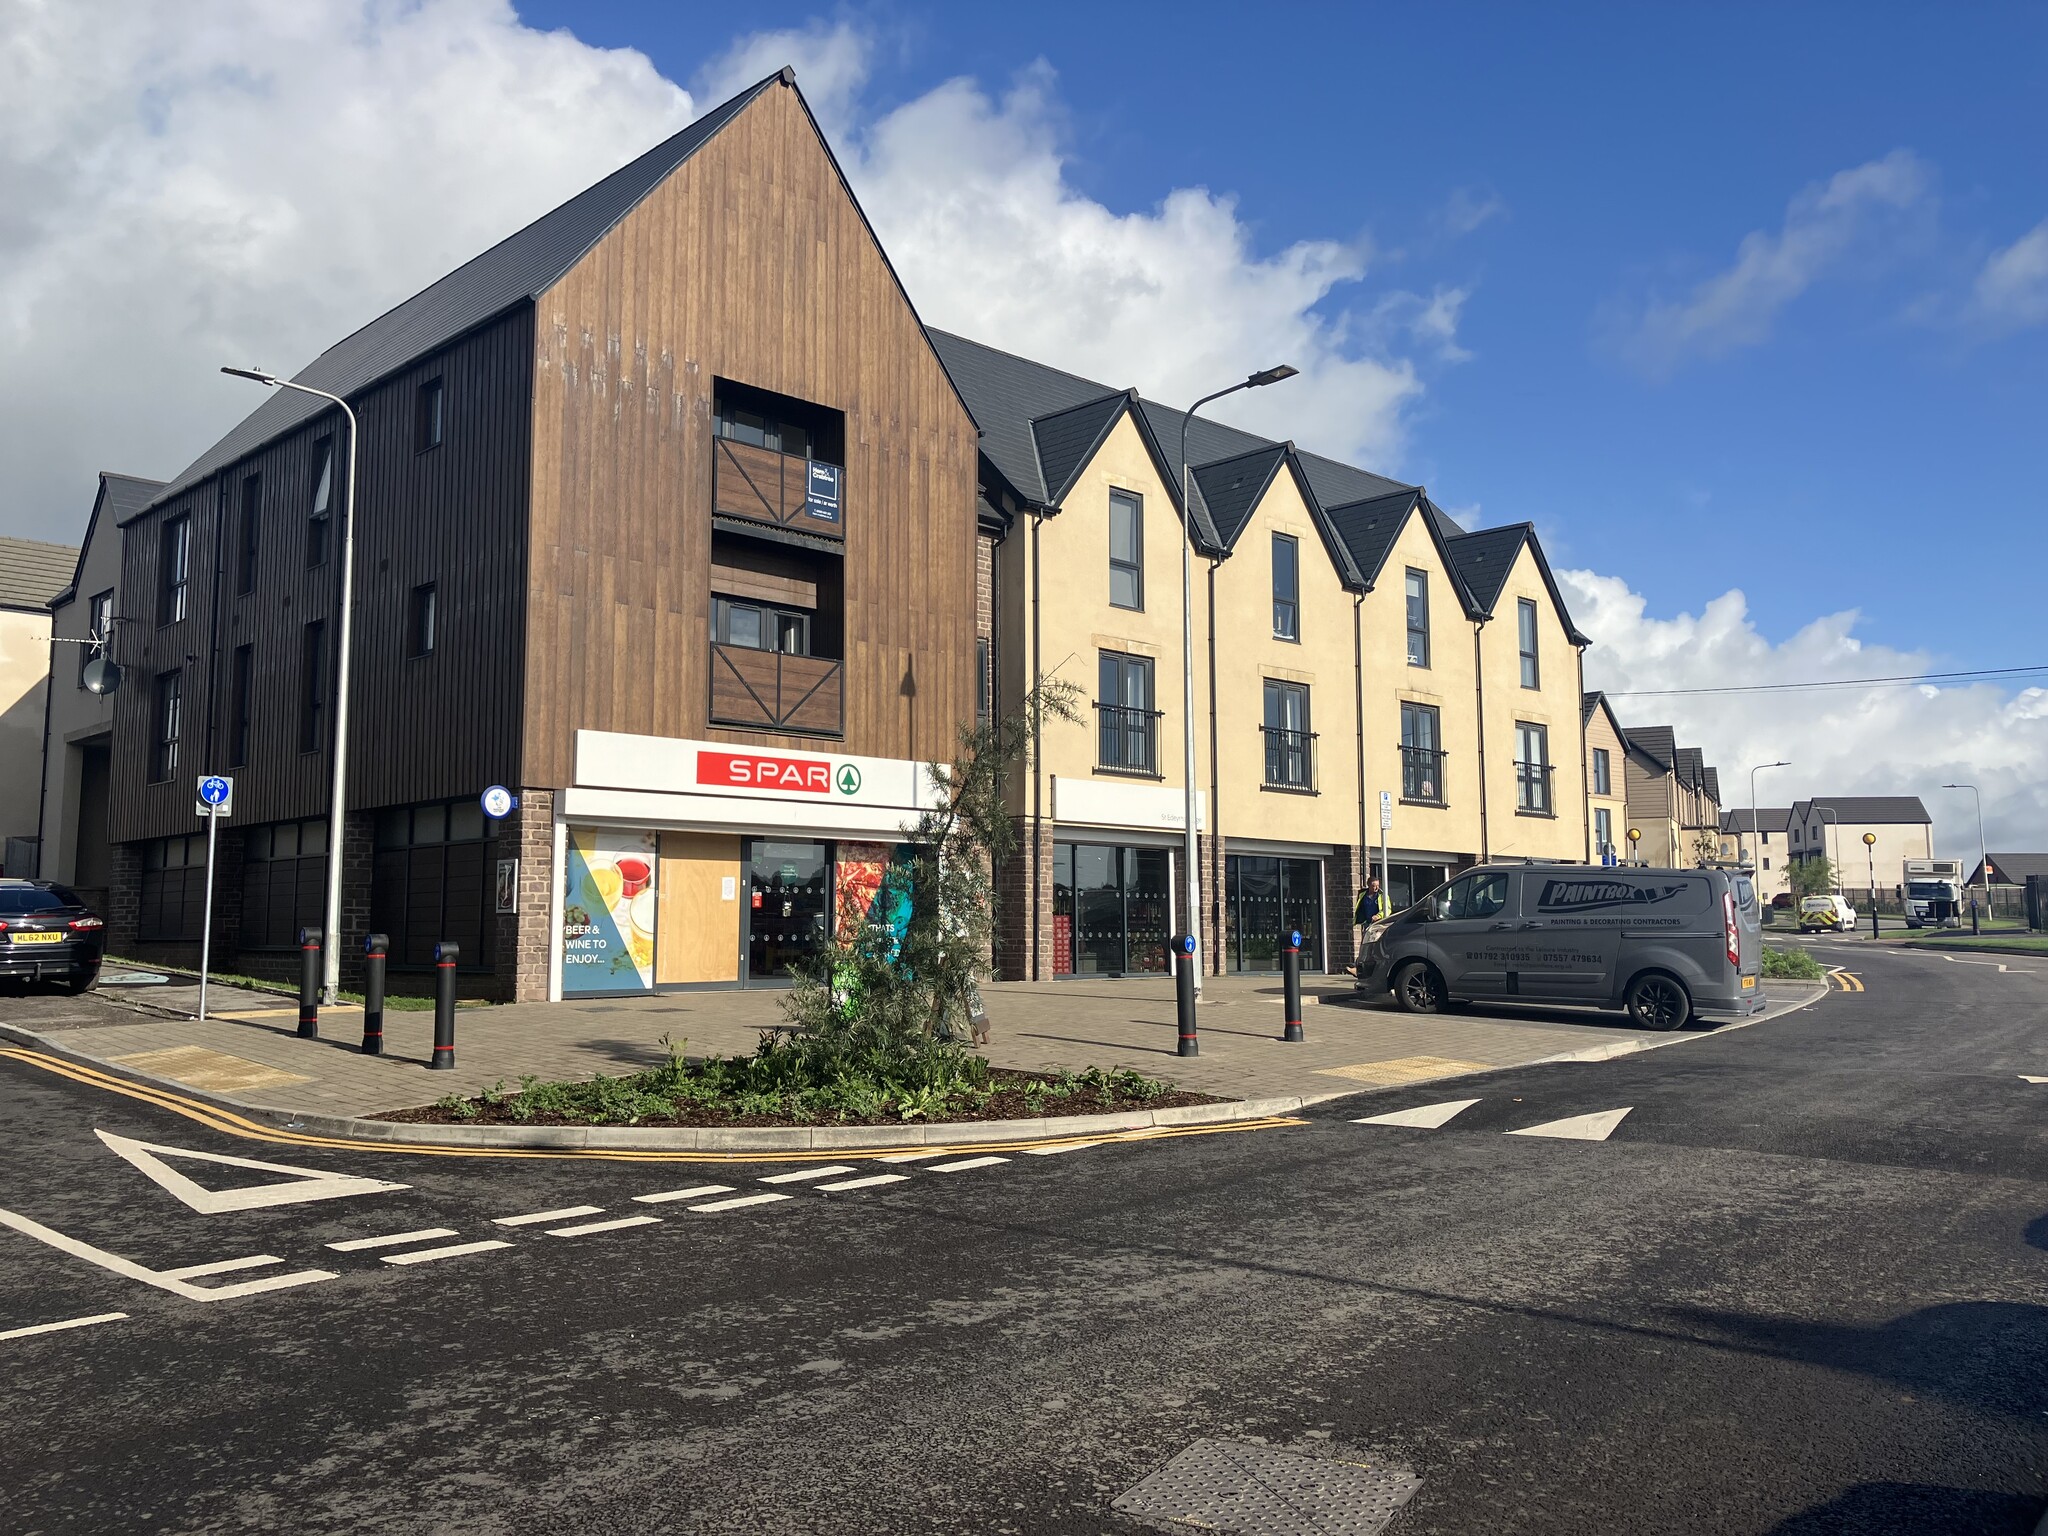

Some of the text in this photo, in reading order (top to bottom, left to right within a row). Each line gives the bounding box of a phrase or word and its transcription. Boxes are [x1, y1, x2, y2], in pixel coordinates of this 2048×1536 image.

[729, 759, 828, 788] SPAR
[1548, 883, 1636, 905] PAINTBOX
[1590, 918, 1629, 926] DECORATING
[1629, 918, 1681, 926] CONTRACTORS
[592, 925, 600, 934] &
[41, 933, 58, 941] NXU
[565, 939, 607, 949] WINE TO
[565, 954, 605, 964] ENJOY...
[1473, 951, 1498, 960] 01792
[1500, 952, 1530, 961] 310935
[1543, 953, 1569, 963] 07557
